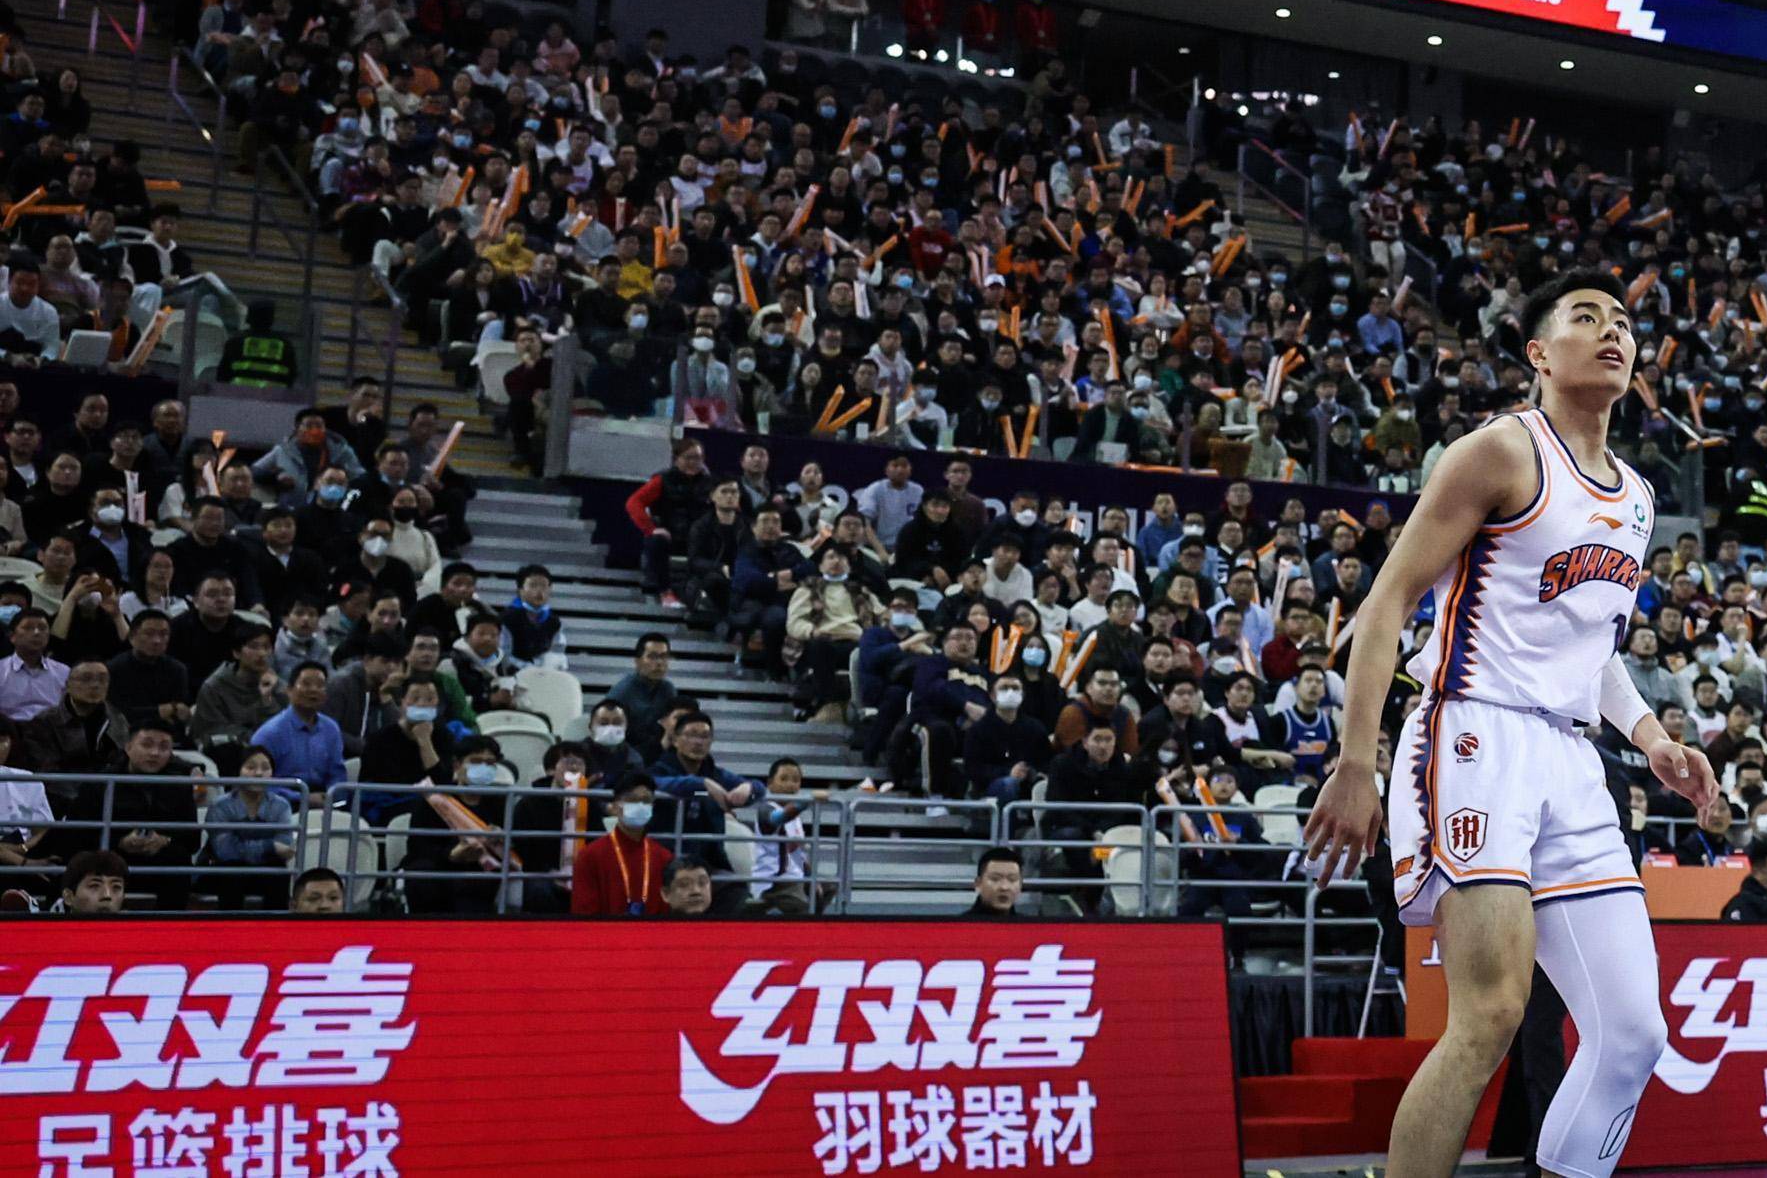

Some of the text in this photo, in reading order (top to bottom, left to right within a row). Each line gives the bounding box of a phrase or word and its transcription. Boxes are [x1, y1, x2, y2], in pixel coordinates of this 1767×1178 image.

[1539, 543, 1640, 603] SHARKS
[0, 945, 418, 1095] 红双喜
[679, 943, 1103, 1124] 红双喜
[38, 1101, 402, 1178] 足篮排球
[813, 1080, 1097, 1176] 羽球器材
